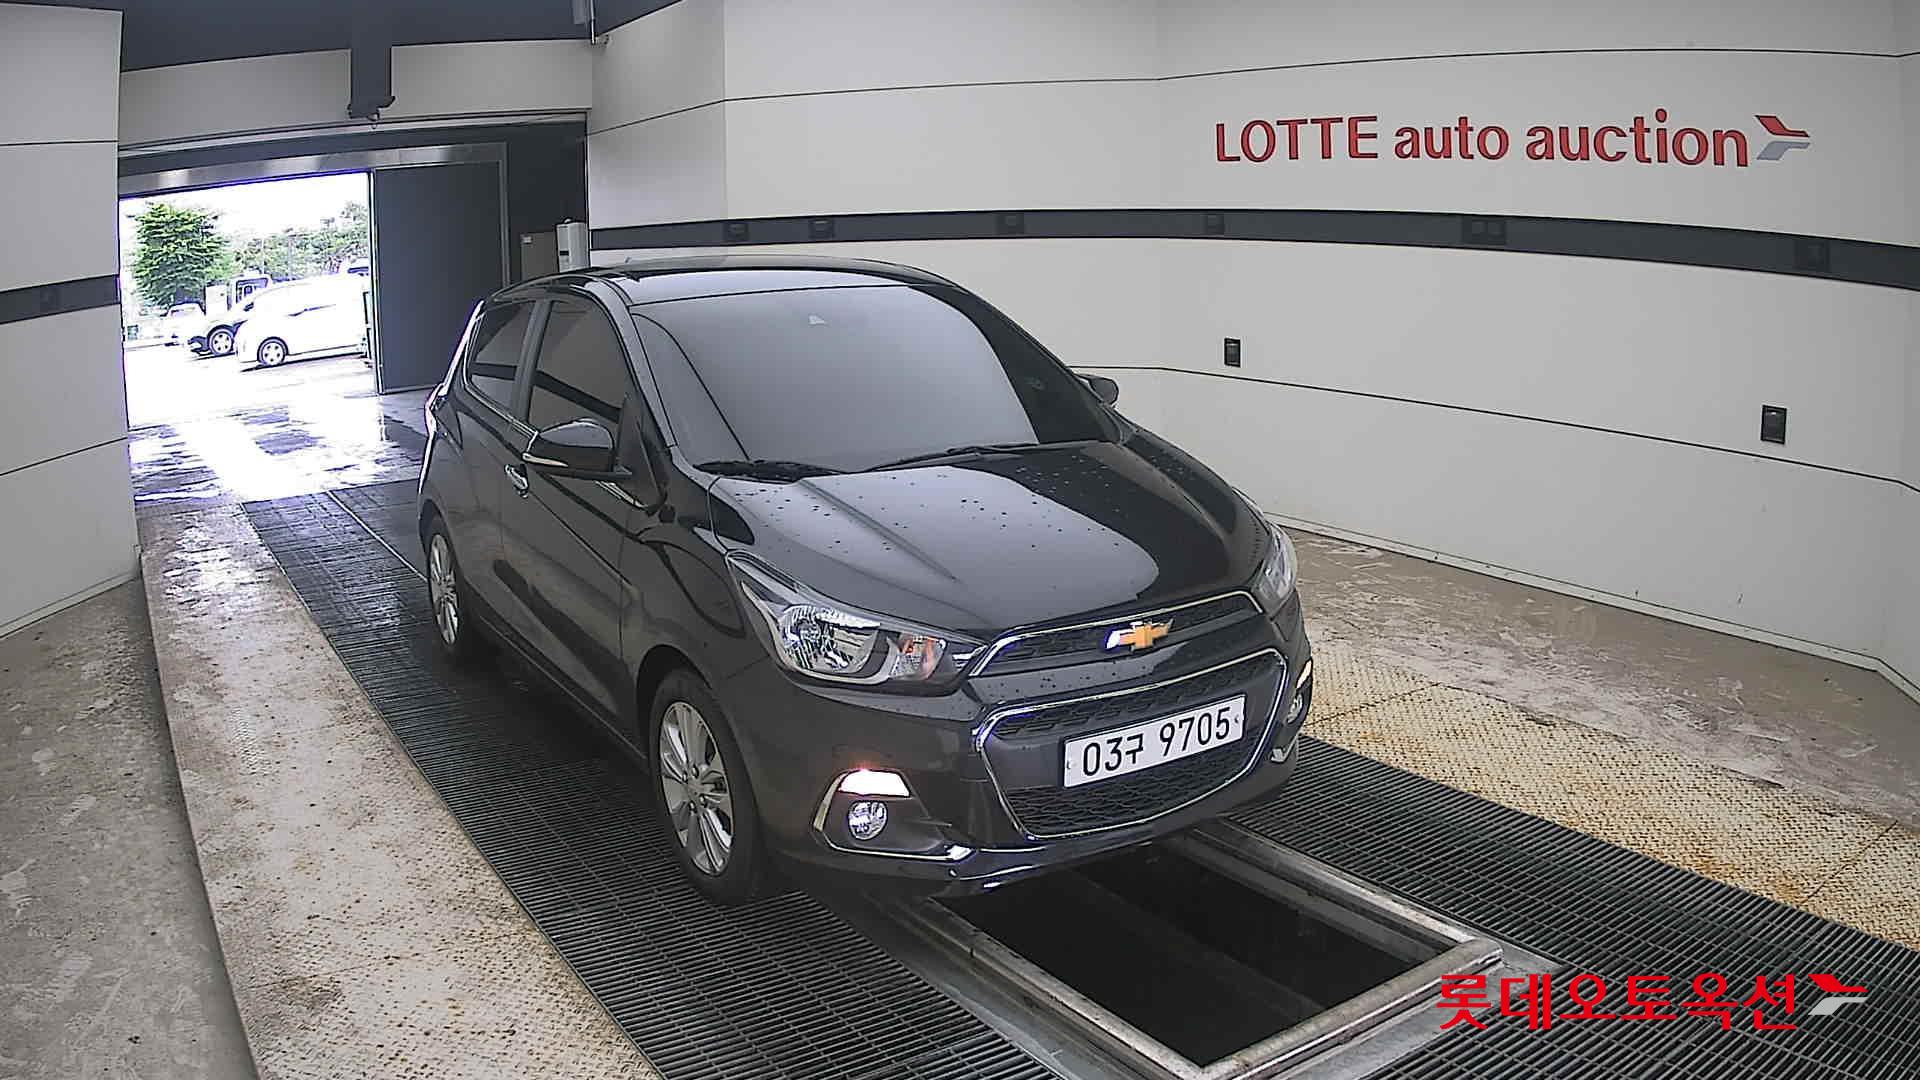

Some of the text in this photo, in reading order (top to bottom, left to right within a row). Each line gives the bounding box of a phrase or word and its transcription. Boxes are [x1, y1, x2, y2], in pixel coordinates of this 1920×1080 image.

[1215, 109, 1749, 168] LOTTE auto auction
[1081, 706, 1232, 776] 03구 9705
